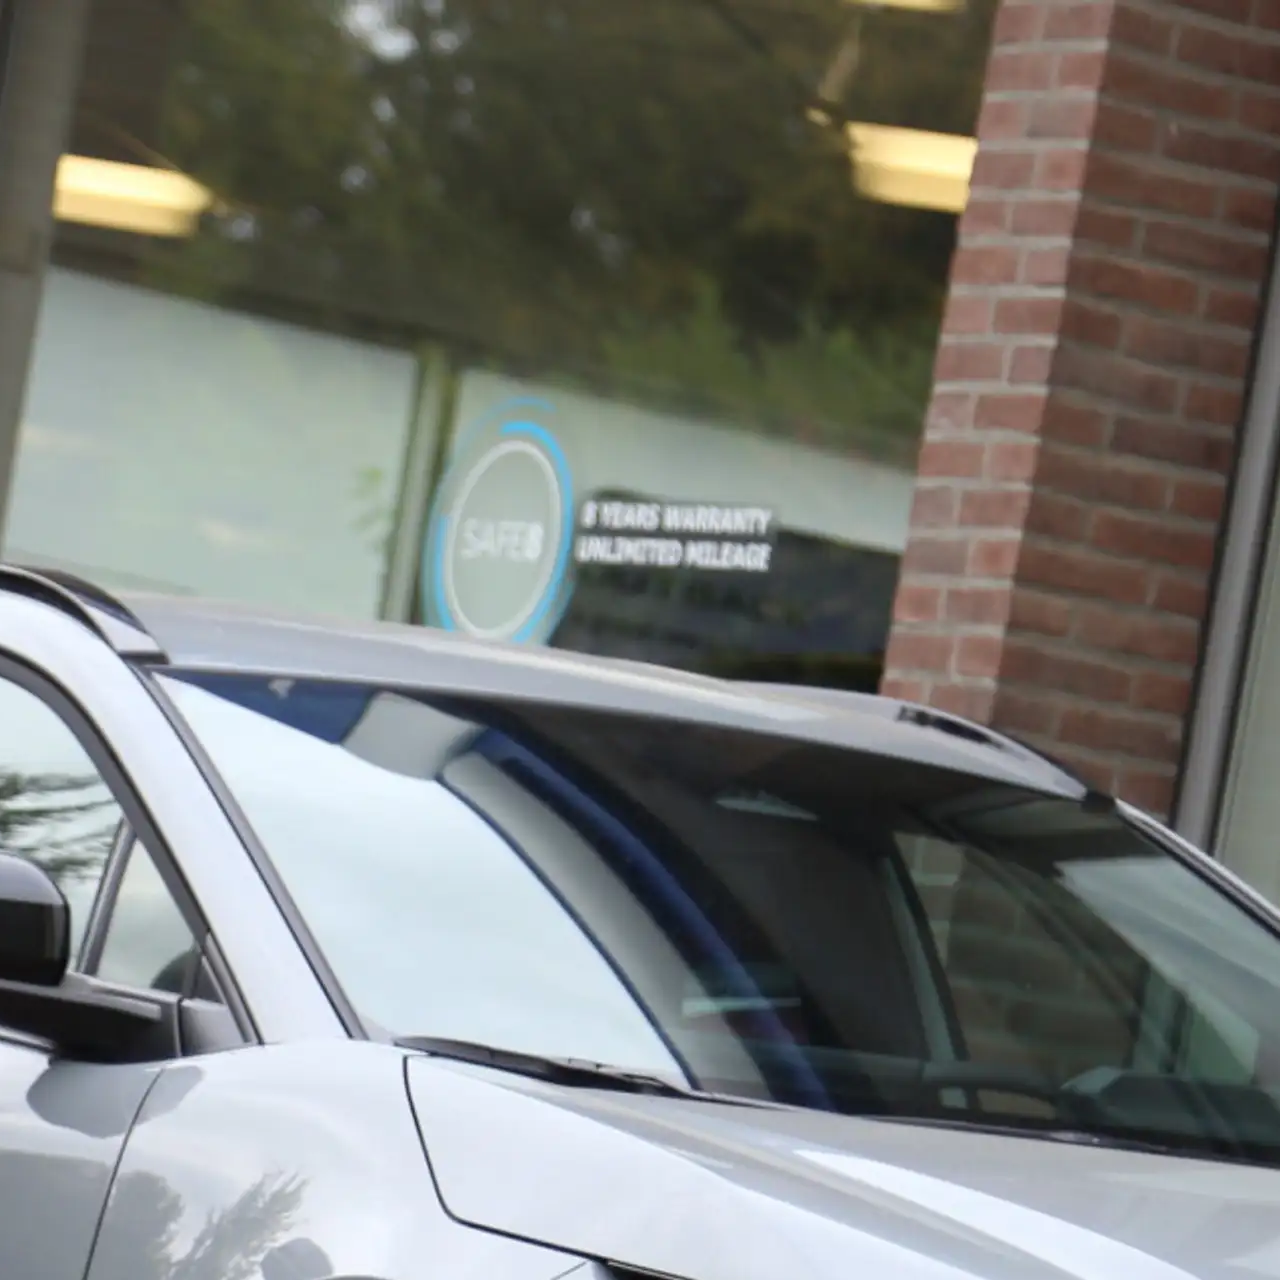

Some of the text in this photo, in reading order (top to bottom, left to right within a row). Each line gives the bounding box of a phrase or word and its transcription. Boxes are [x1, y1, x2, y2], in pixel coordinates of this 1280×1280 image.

[599, 502, 660, 530] YEARS
[662, 505, 772, 535] WARRANTY
[576, 535, 772, 572] UNLIMITED MILEAGE
